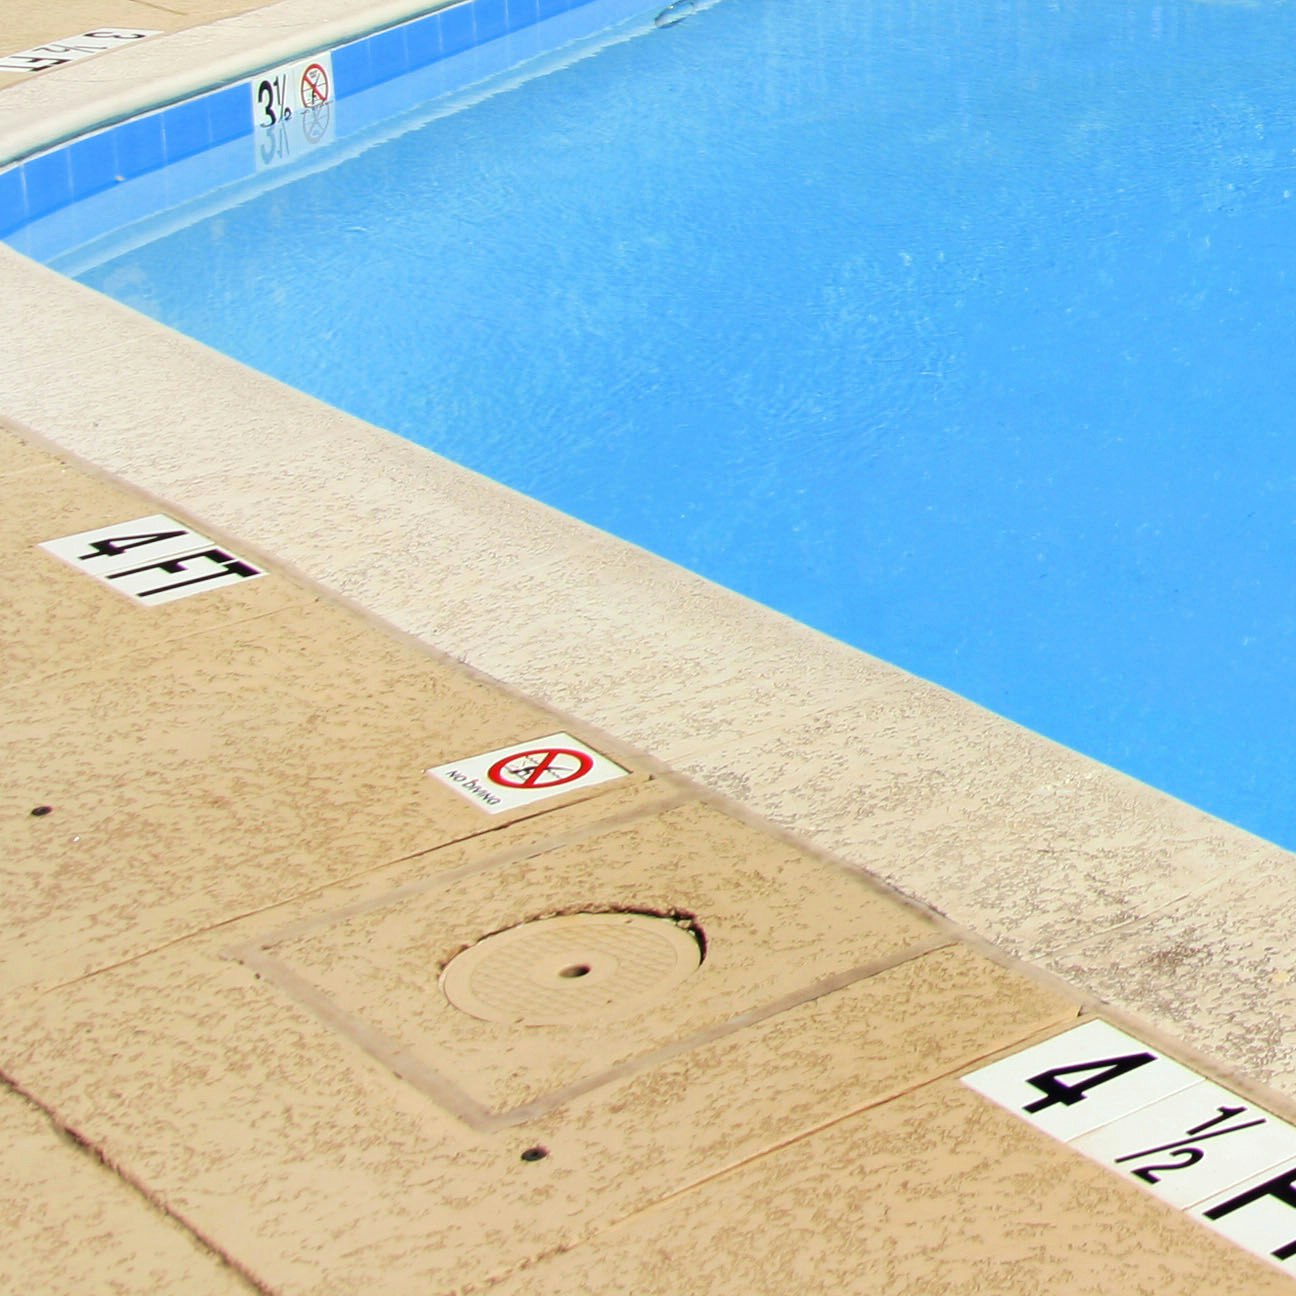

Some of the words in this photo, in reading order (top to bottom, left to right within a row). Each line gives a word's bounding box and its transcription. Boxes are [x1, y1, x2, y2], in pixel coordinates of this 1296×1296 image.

[77, 530, 189, 560] 4
[105, 548, 262, 597] FT
[1022, 1051, 1158, 1115] 4
